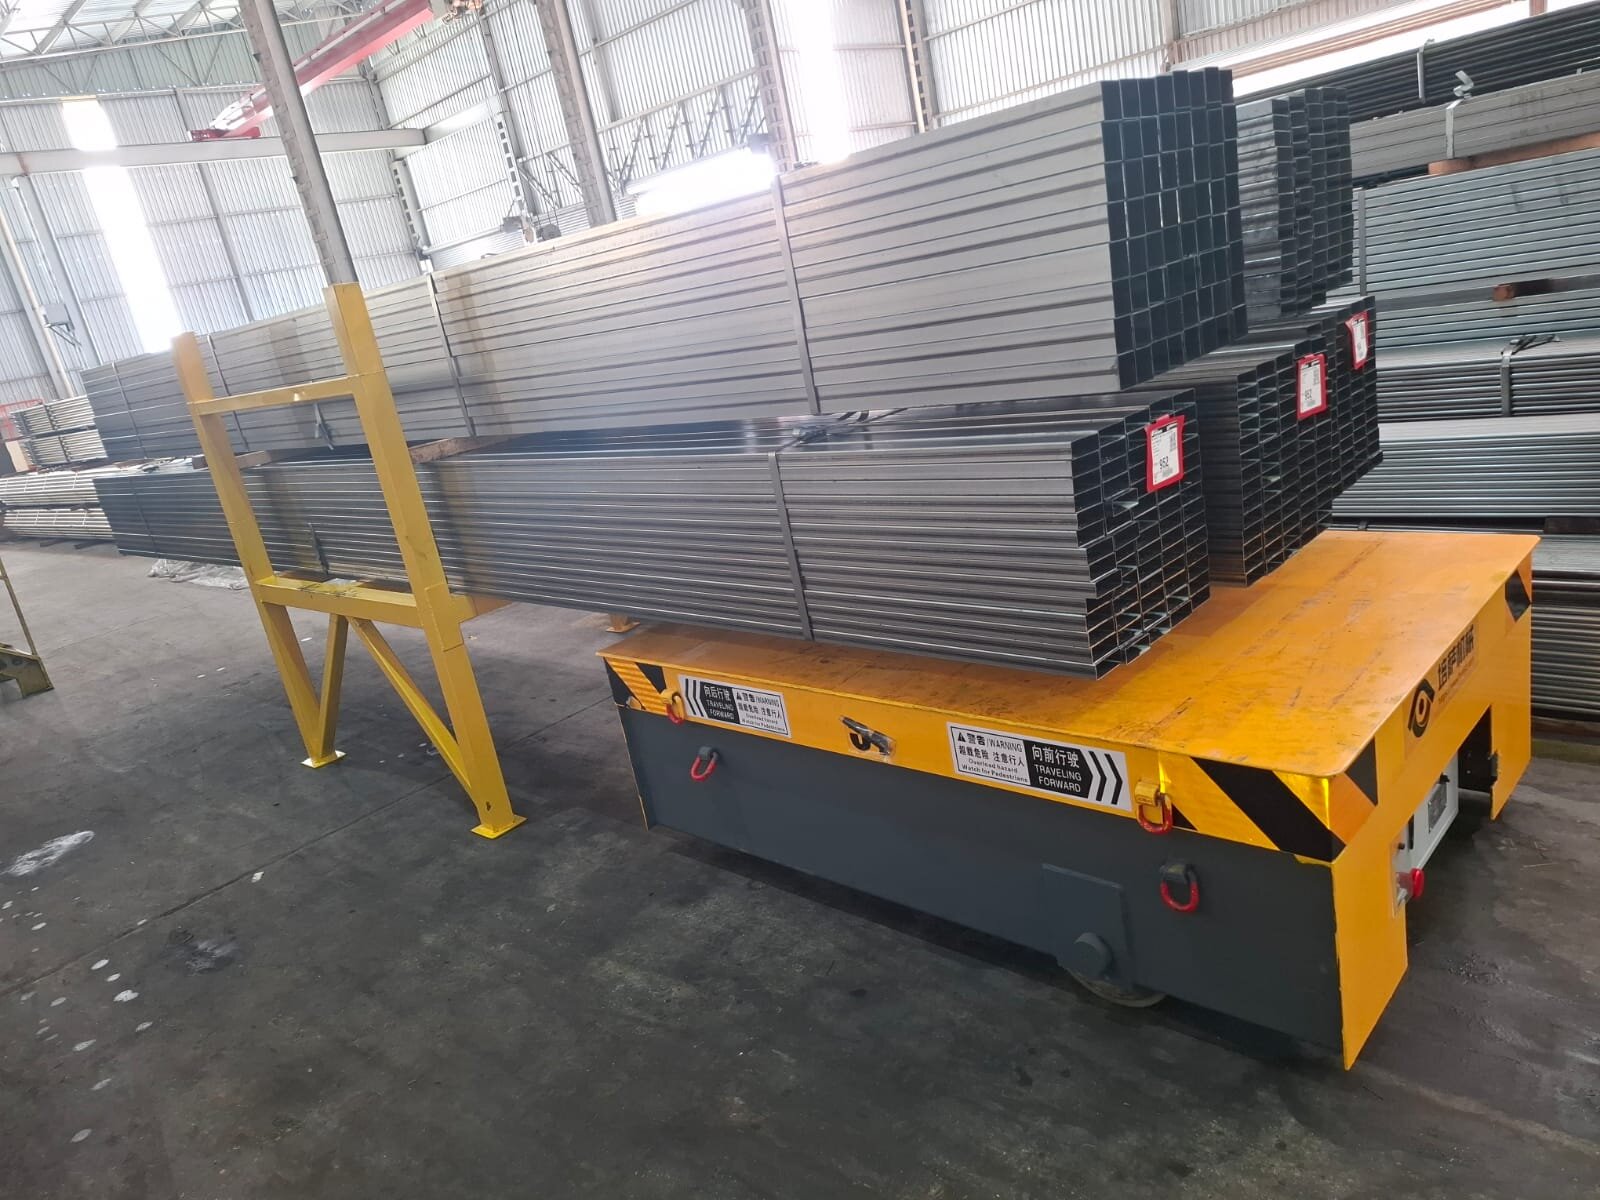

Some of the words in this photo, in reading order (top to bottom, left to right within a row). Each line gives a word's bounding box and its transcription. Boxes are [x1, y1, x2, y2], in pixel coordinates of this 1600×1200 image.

[1159, 456, 1169, 470] 952
[993, 751, 1025, 767] 注意行人
[1032, 744, 1080, 768] 向前行驶
[1034, 764, 1081, 781] TRAVELING
[1038, 776, 1081, 793] FORWARD
